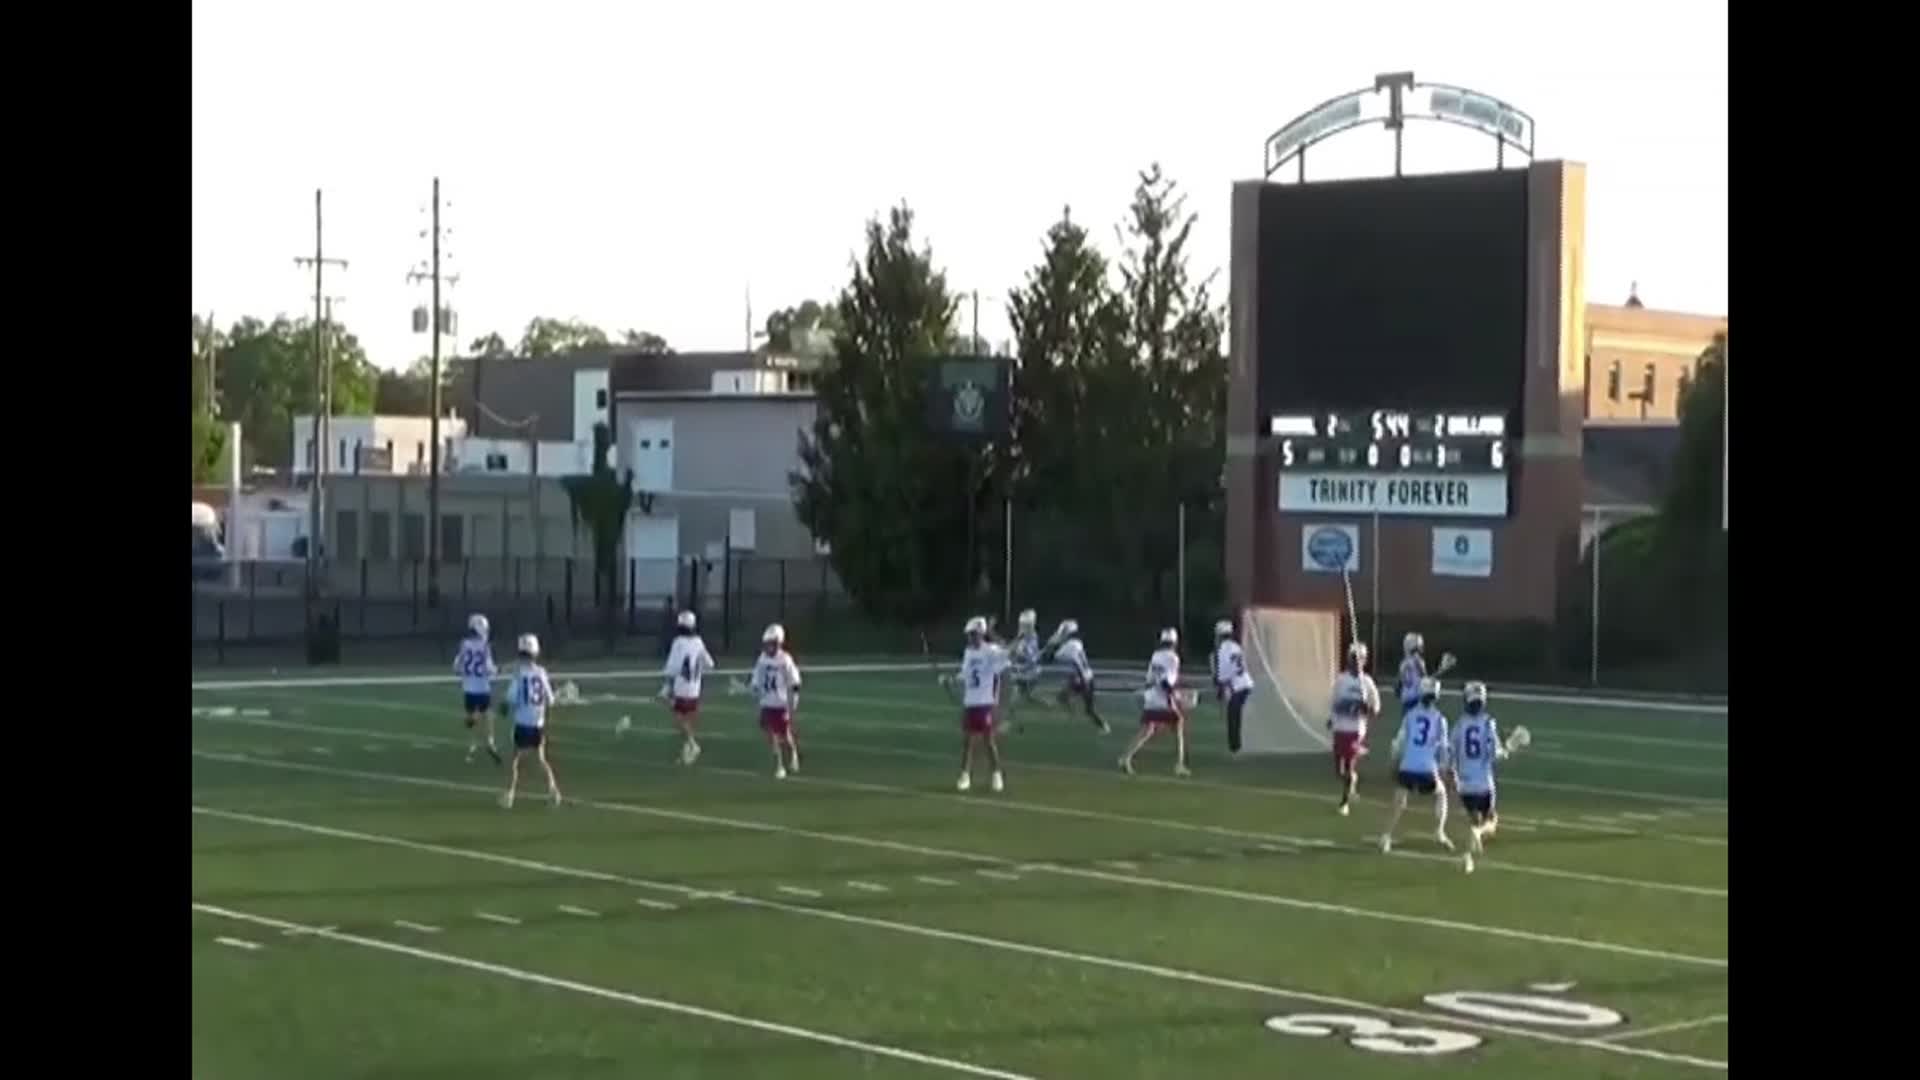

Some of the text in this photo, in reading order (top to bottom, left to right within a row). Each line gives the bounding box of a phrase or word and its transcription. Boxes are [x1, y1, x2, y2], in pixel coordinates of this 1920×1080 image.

[1375, 71, 1414, 130] T
[1282, 439, 1294, 467] 5
[1490, 440, 1504, 469] 6
[1309, 478, 1469, 506] TRINITY FOREVER
[463, 649, 486, 678] 22
[522, 676, 545, 706] 13
[1413, 716, 1431, 747] 3
[1464, 725, 1481, 760] 6
